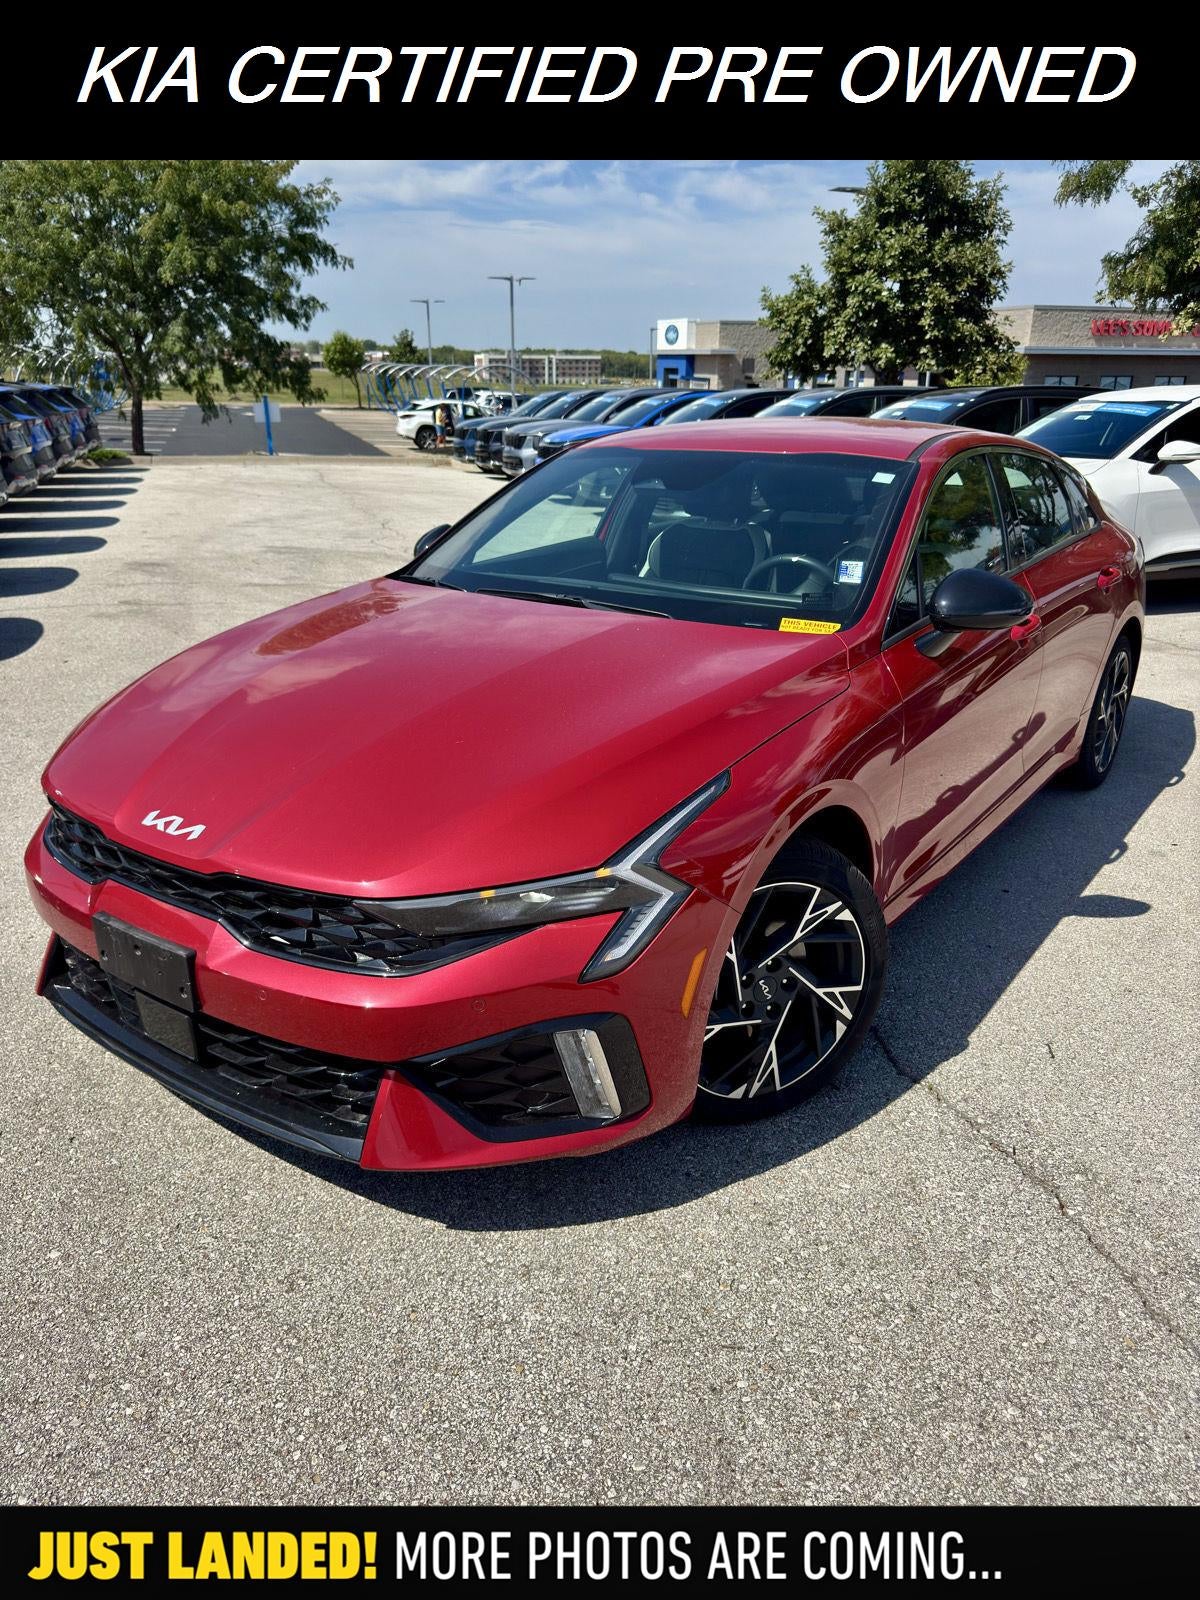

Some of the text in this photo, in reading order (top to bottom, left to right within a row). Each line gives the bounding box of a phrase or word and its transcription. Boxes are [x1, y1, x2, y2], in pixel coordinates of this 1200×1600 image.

[1091, 319, 1130, 337] LEE'S
[804, 621, 839, 630] VEHICLE
[141, 809, 206, 841] KIA
